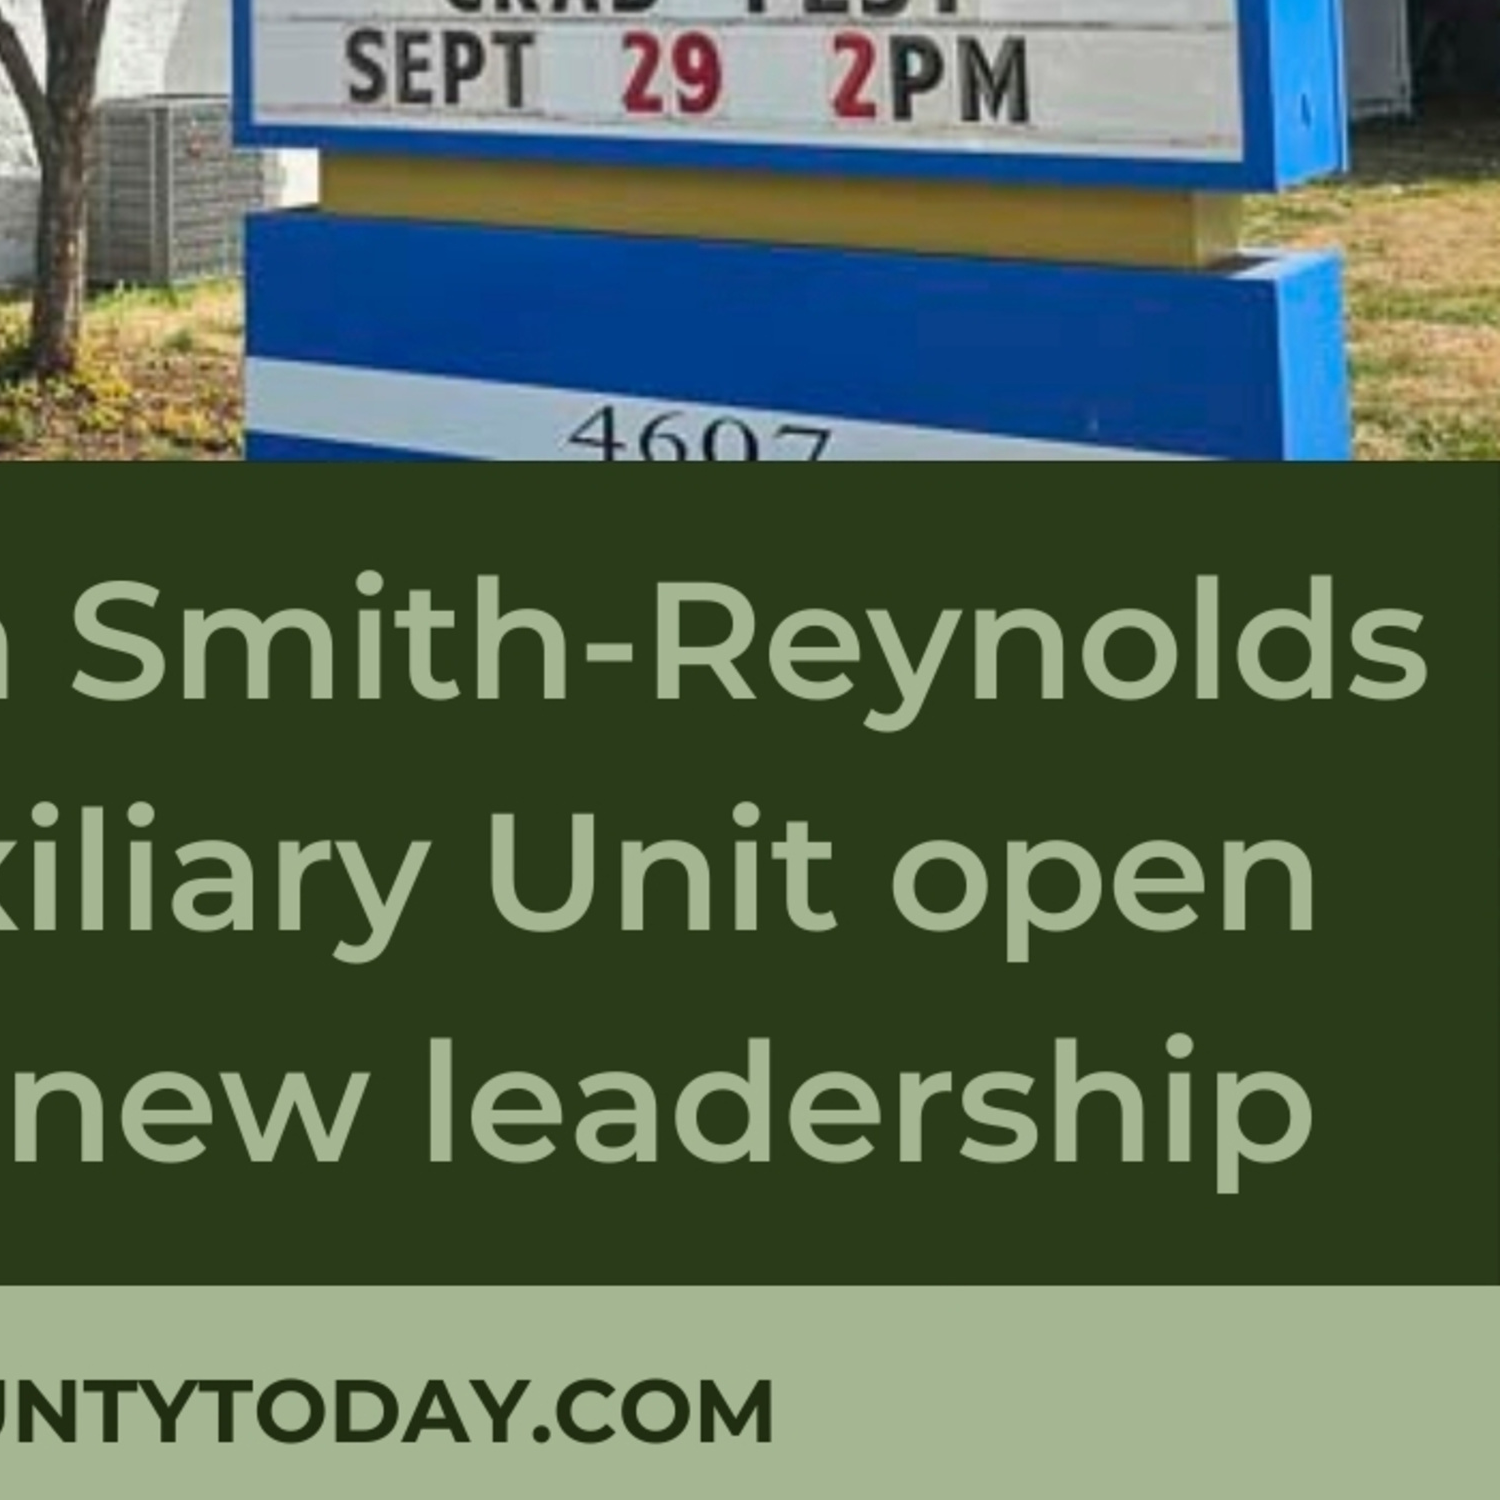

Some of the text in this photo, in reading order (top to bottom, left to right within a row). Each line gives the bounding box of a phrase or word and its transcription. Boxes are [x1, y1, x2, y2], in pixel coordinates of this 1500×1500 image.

[345, 30, 1031, 124] SEPT 29 2PM
